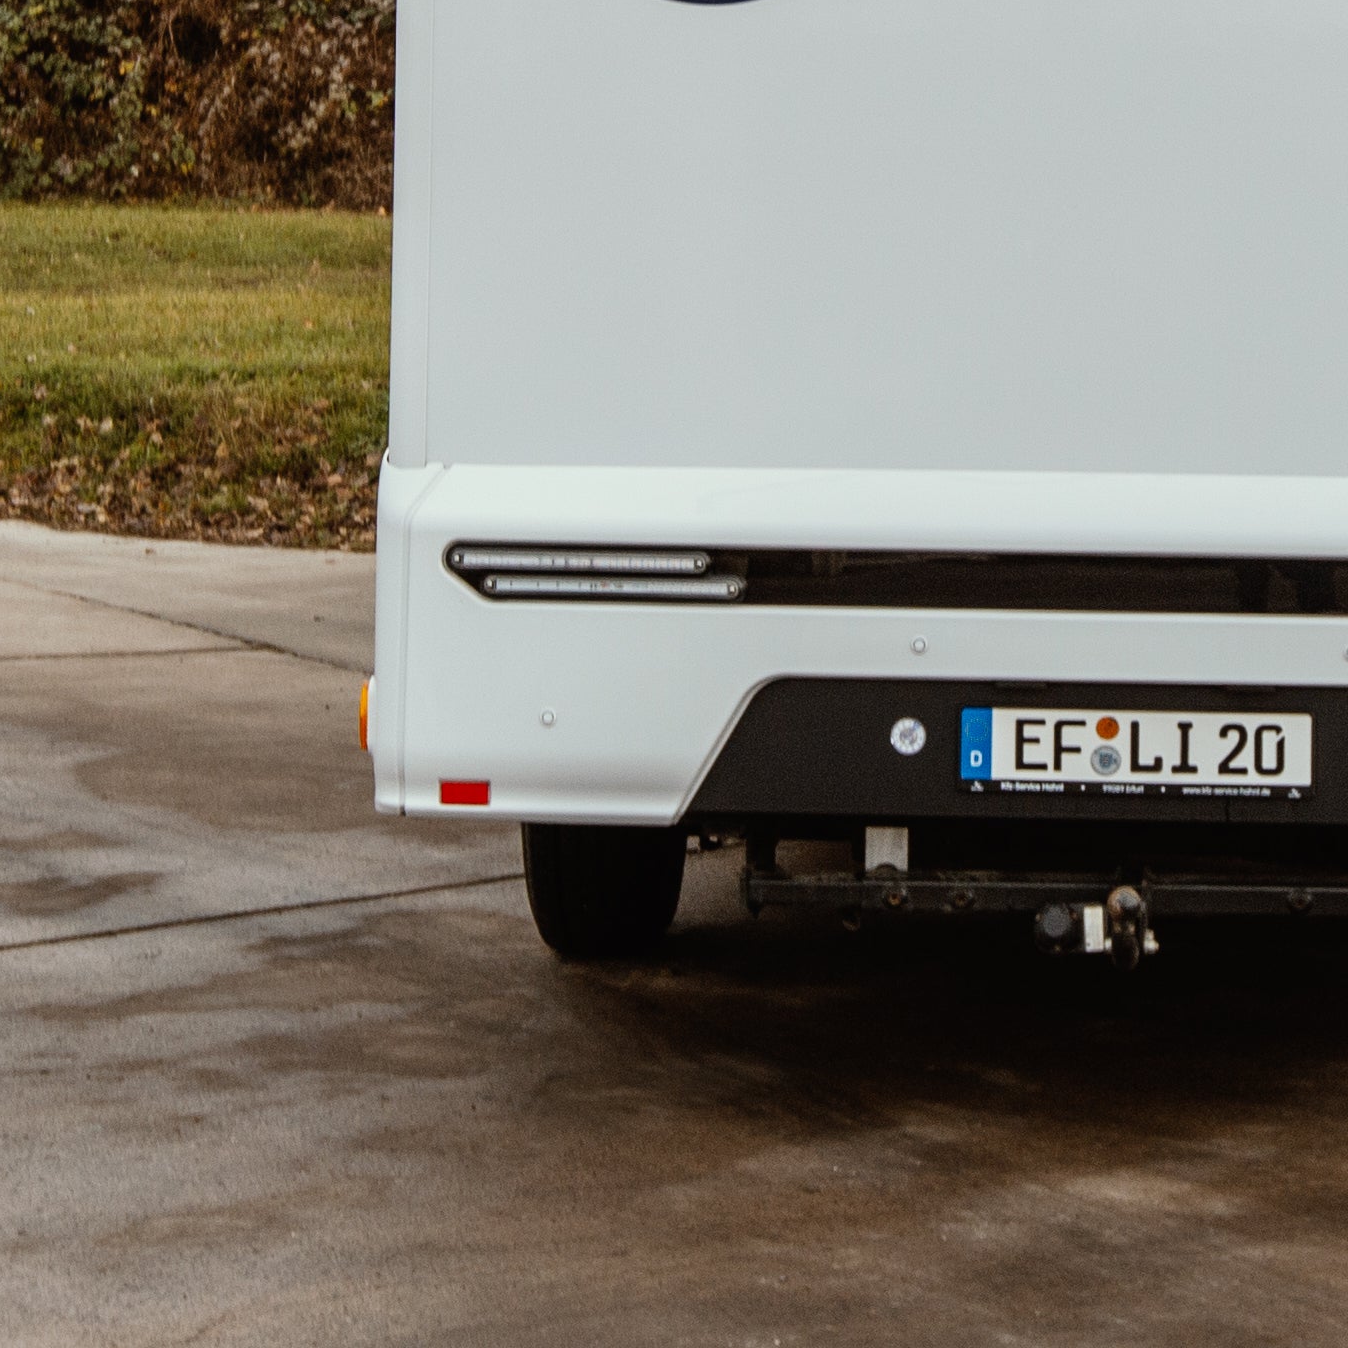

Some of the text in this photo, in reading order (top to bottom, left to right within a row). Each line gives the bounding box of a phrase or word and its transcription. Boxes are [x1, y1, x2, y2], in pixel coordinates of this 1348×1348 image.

[970, 750, 983, 767] D
[1015, 719, 1286, 776] EF LI 20
